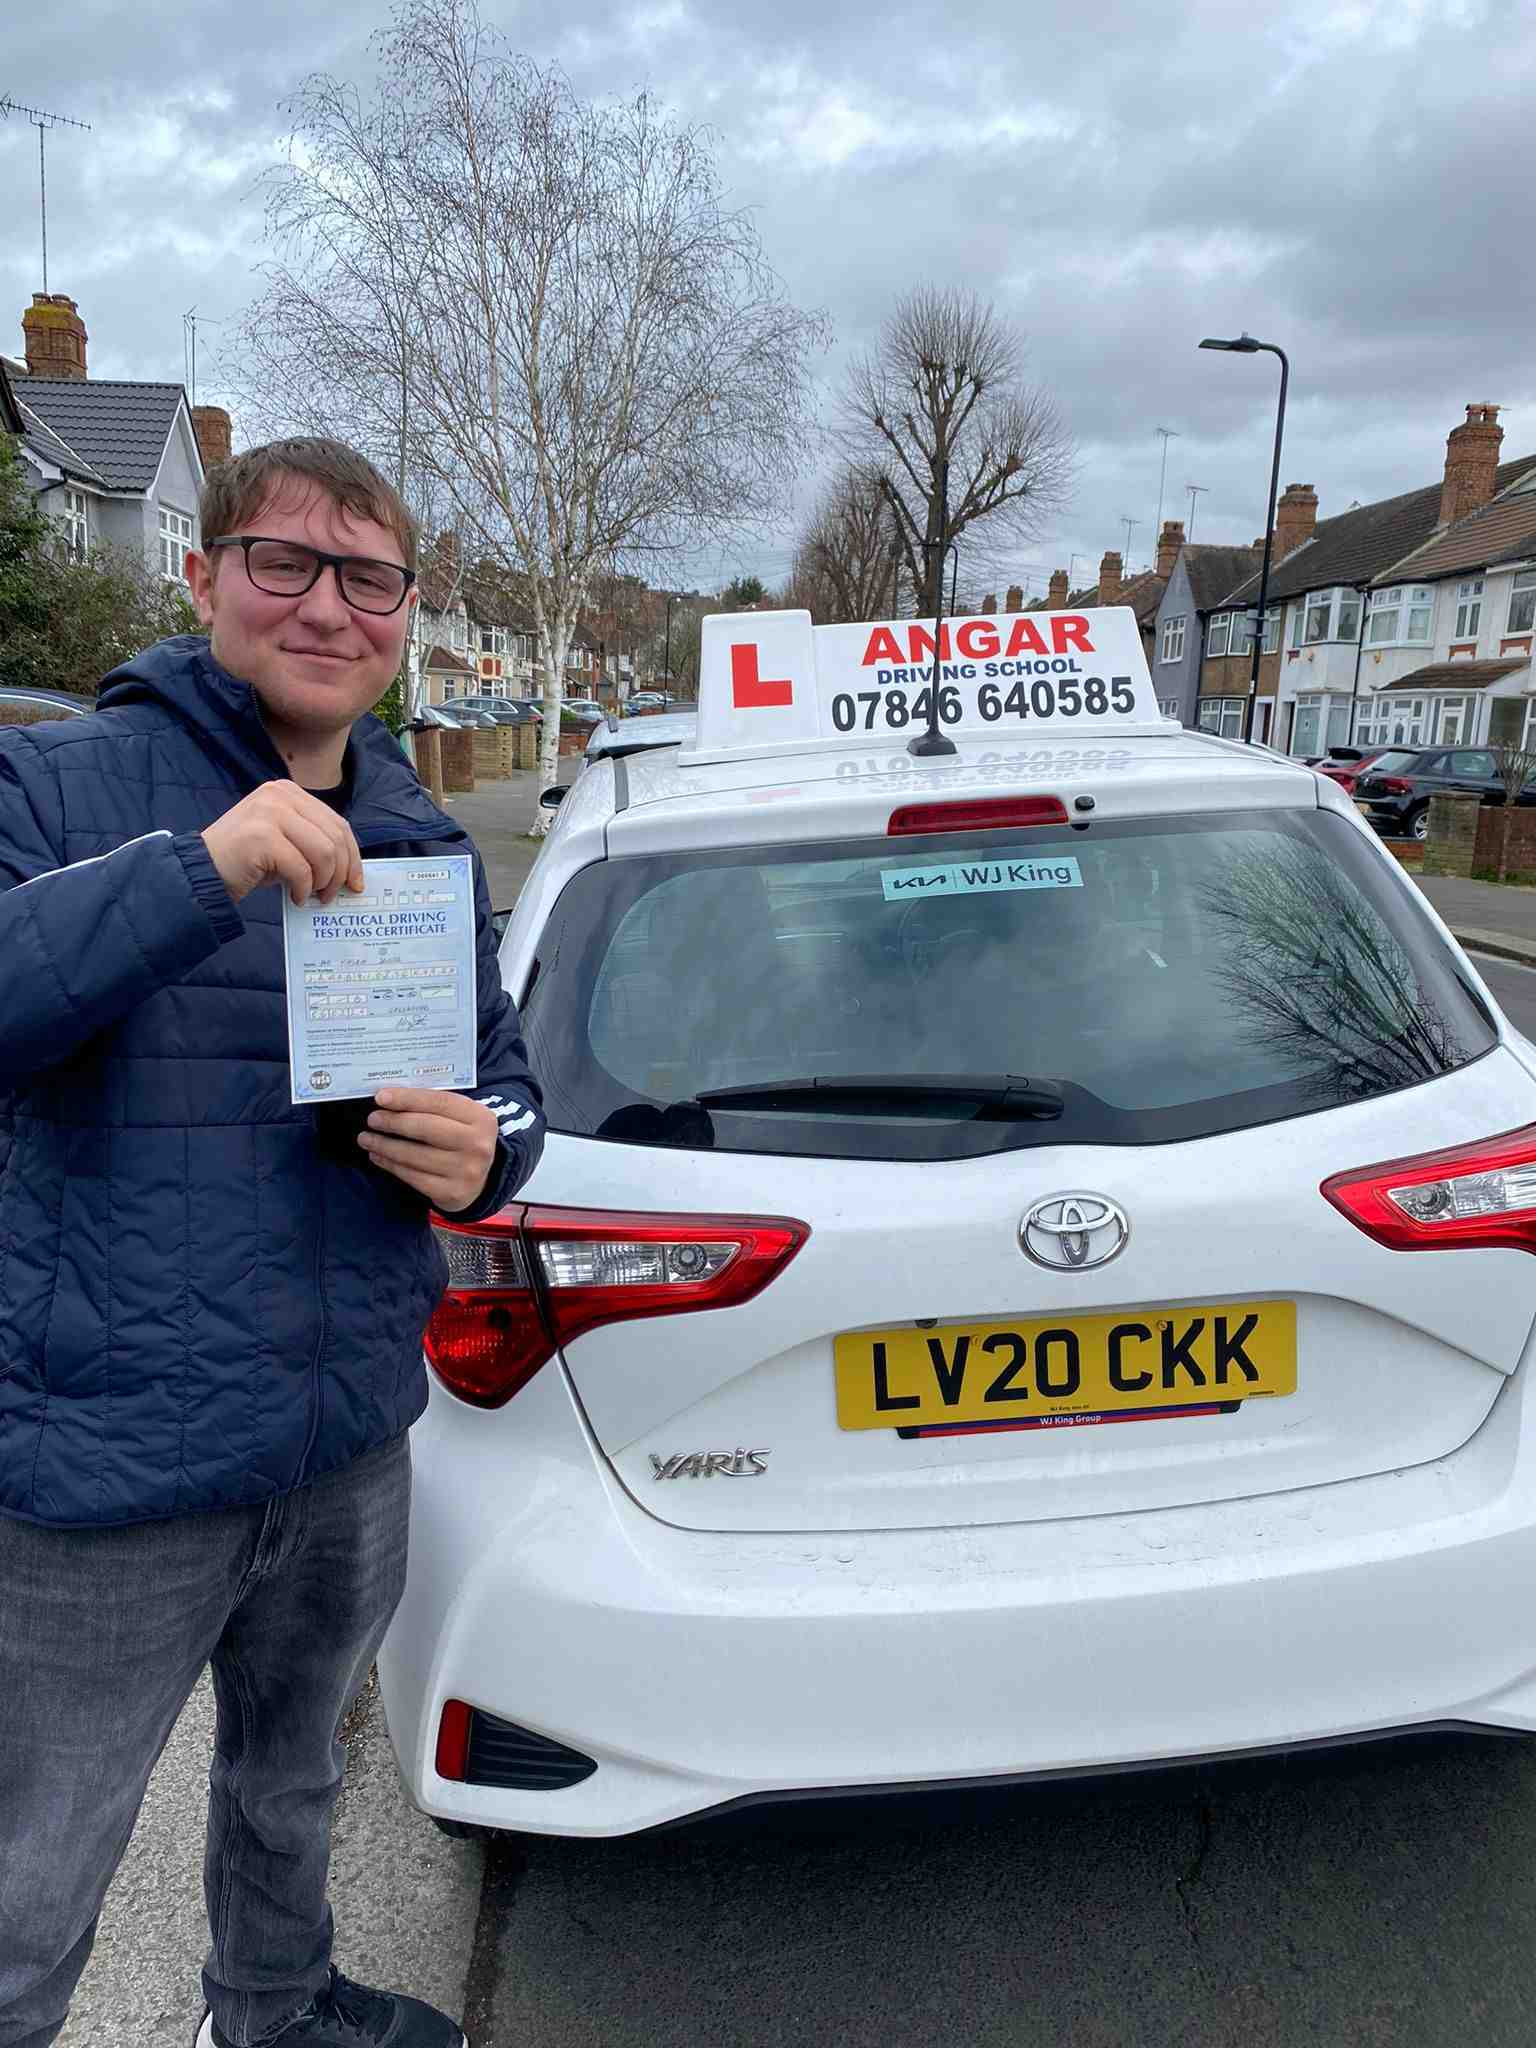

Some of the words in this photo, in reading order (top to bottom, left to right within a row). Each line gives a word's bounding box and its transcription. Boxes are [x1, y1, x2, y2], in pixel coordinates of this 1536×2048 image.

[861, 615, 1096, 666] ANGAR
[731, 643, 793, 709] L
[877, 665, 976, 684] DRIVNG
[984, 658, 1082, 677] SCHOOL
[831, 686, 963, 732] 07846
[977, 676, 1136, 722] 640585
[962, 866, 1002, 885] WJ
[1008, 864, 1072, 884] King
[313, 914, 385, 926] PRACTICAL
[389, 911, 447, 924] DRIVING
[314, 928, 340, 938] TEST
[345, 927, 372, 937] PASS
[375, 923, 447, 936] CERTIFICATE
[872, 1328, 1081, 1411] LV20
[1108, 1314, 1260, 1392] CKK
[1040, 1416, 1053, 1425] WJ
[1055, 1415, 1074, 1425] King
[1075, 1414, 1102, 1424] Group
